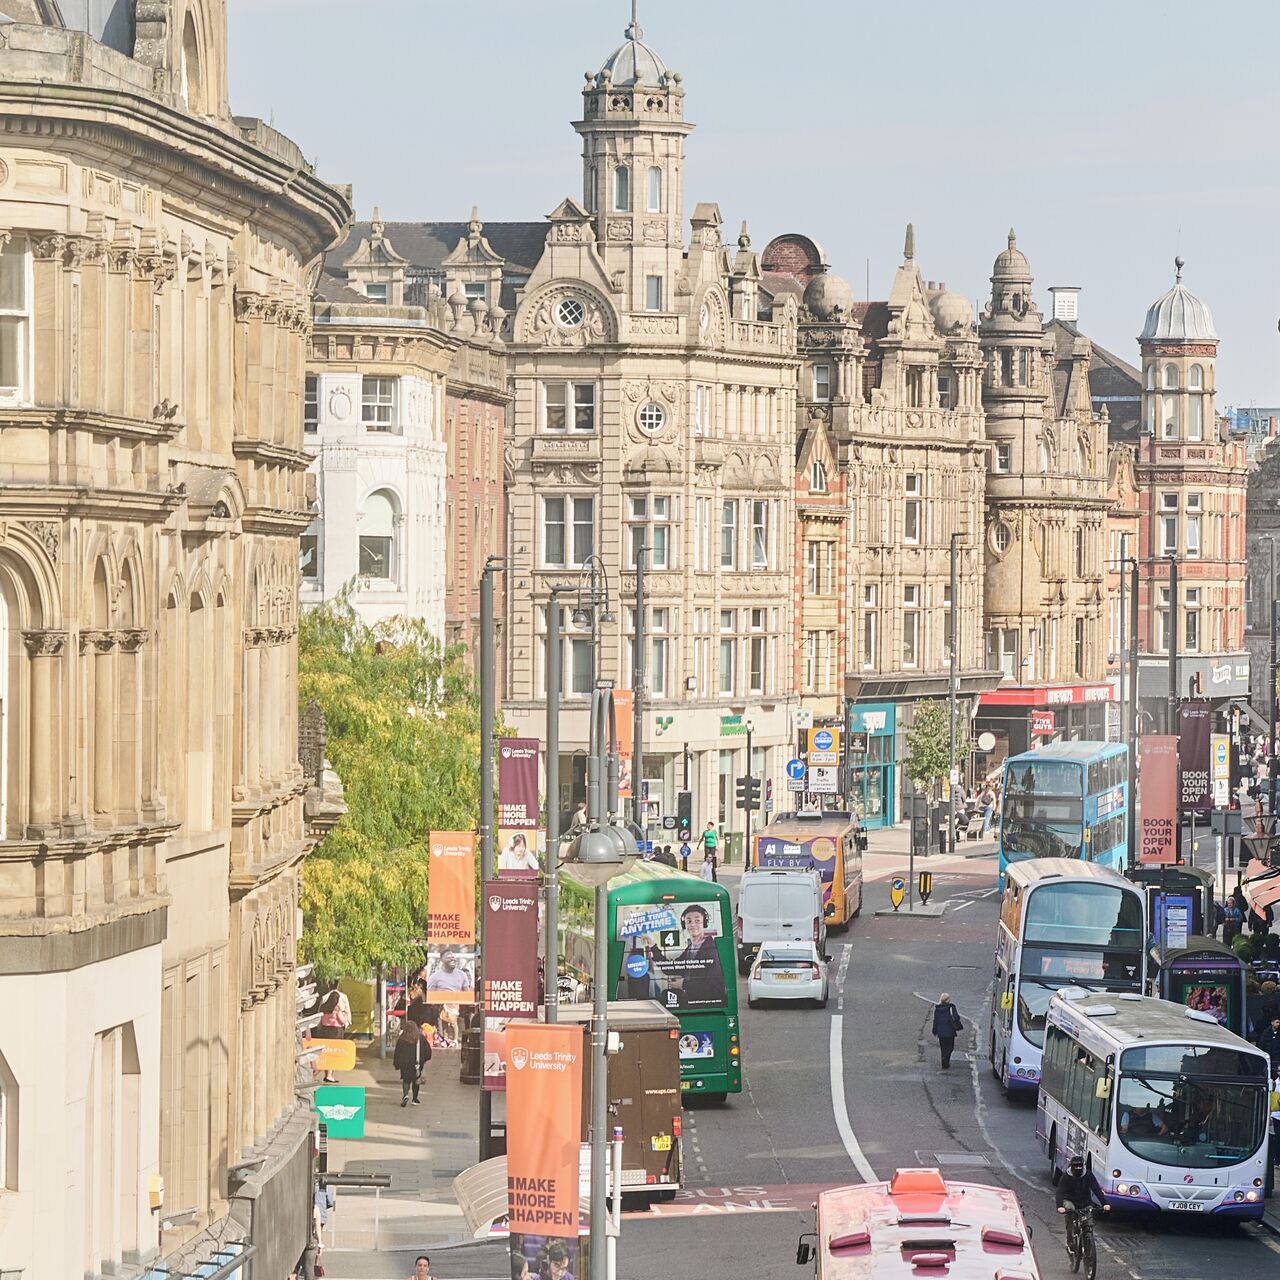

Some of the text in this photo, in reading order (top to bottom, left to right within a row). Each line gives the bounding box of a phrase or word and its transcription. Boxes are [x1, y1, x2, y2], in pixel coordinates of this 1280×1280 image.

[1034, 723, 1053, 731] GUYS
[1182, 771, 1209, 780] BOOK
[1182, 779, 1208, 787] YOUR
[1182, 787, 1208, 795] OPEN
[1182, 795, 1201, 804] DAY
[503, 804, 527, 812] MAKE
[503, 811, 527, 819] MORE
[503, 818, 536, 826] HAPPEN
[1143, 818, 1173, 827] BOOK
[1143, 827, 1173, 837] YOUR
[1143, 837, 1172, 846] OPEN
[1143, 846, 1164, 856] DAY
[502, 897, 535, 907] Leeds Trinity
[502, 903, 529, 912] University
[433, 913, 461, 922] MAKE
[433, 922, 461, 930] MORE
[620, 916, 672, 935] ANYTIME
[433, 930, 471, 939] HAPPEN
[491, 981, 523, 991] MAKE
[491, 991, 523, 1001] MORE
[491, 1001, 535, 1012] HAPPEN
[529, 1051, 577, 1064] Leeds Trinity
[529, 1060, 566, 1072] University
[645, 1087, 677, 1095] www.ups.com
[515, 1177, 556, 1193] MAKE
[515, 1193, 556, 1209] MORE
[1172, 1202, 1202, 1211] YJ08 CEY
[515, 1209, 573, 1226] HAPPEN
